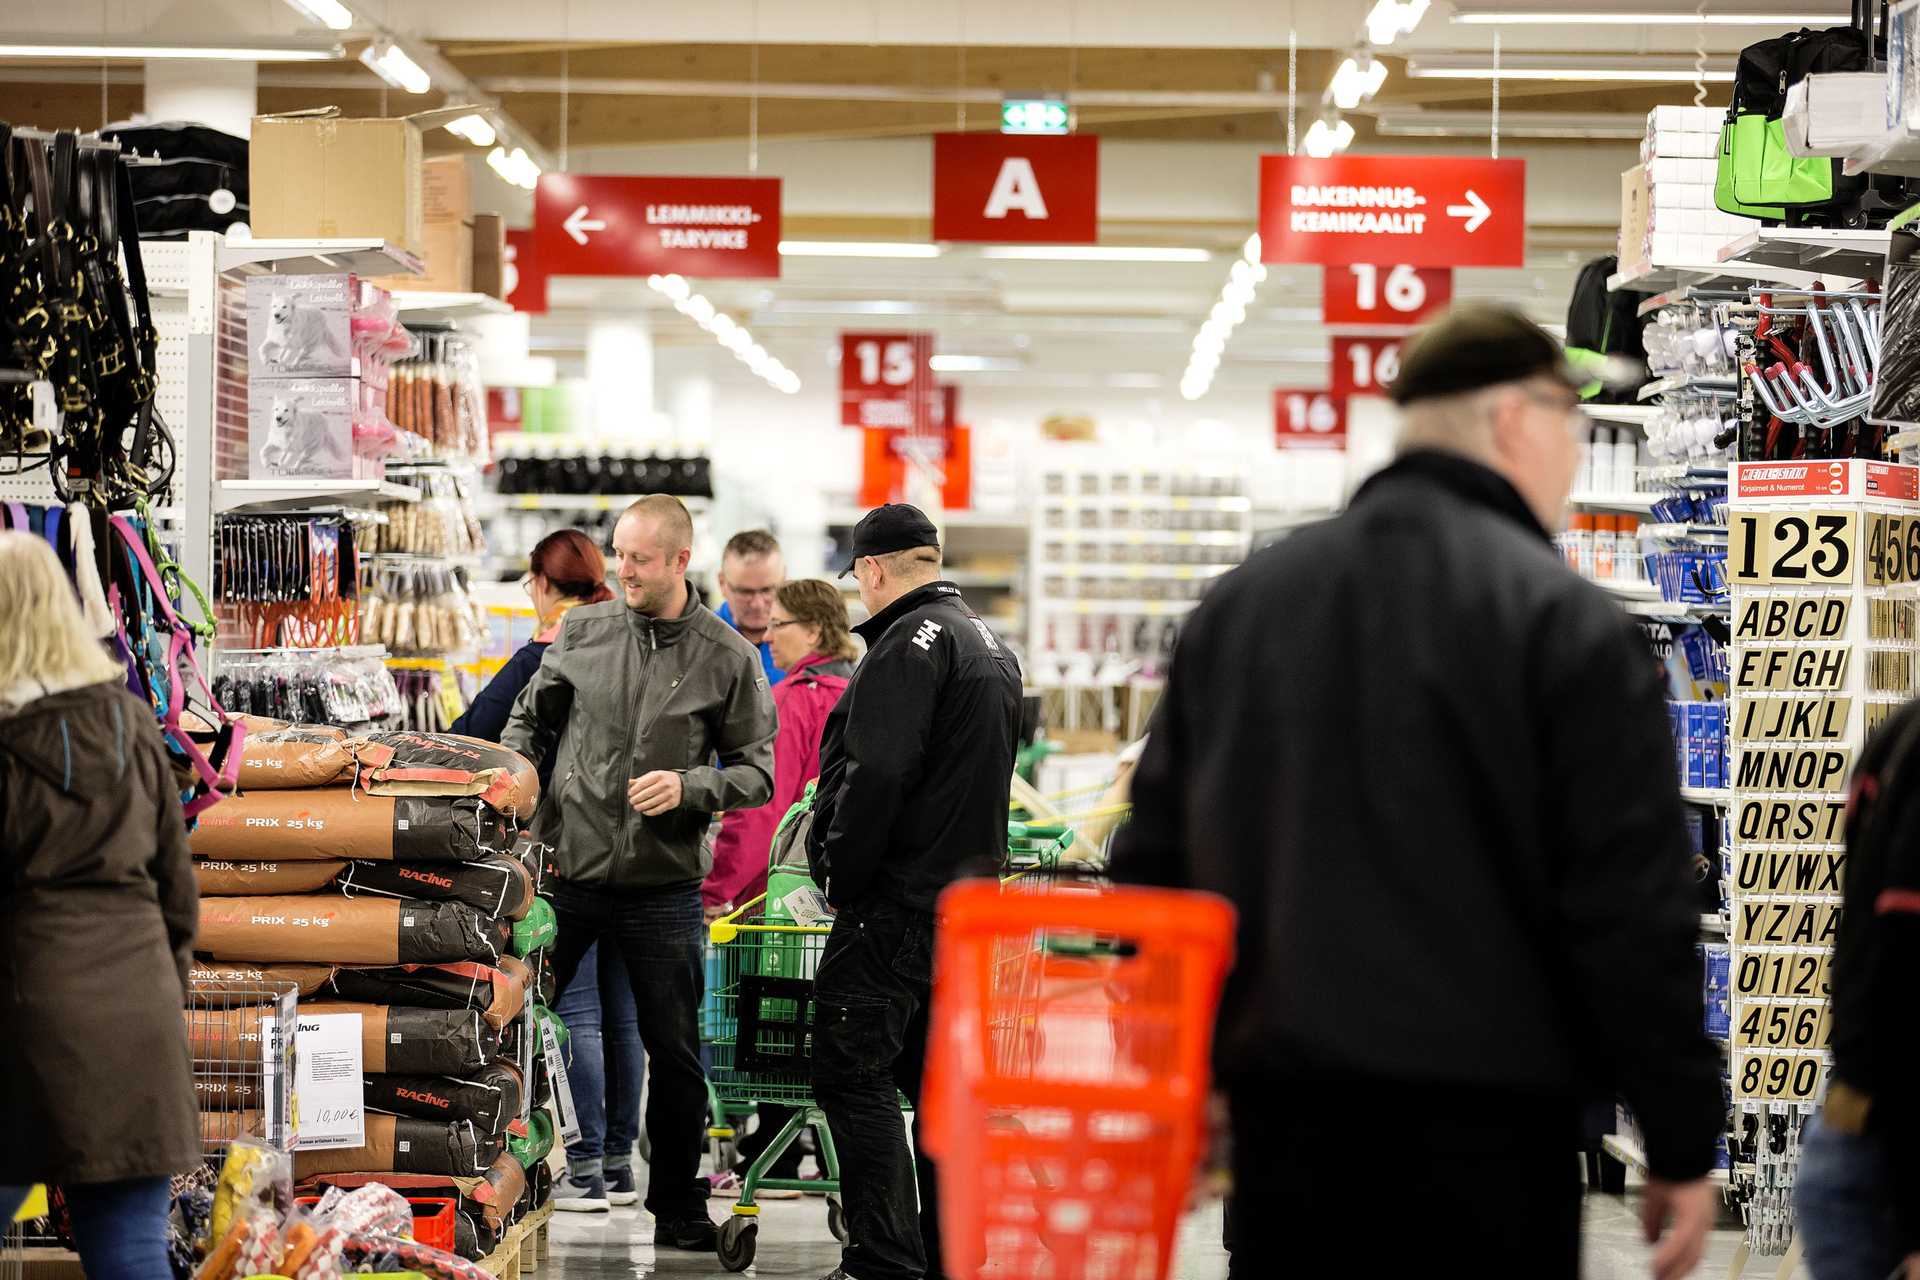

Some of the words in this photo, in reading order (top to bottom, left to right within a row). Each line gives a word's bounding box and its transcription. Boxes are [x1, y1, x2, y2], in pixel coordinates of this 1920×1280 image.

[983, 157, 1049, 219] A
[1290, 186, 1426, 208] RAKENNUS-
[646, 204, 762, 225] LEMMIKKI-
[1290, 211, 1426, 233] KEMIKAALIT
[659, 229, 748, 249] TARVIKE
[1350, 264, 1427, 312] 16
[856, 341, 914, 385] 15
[1286, 394, 1337, 433] 16
[911, 619, 942, 651] HH
[246, 760, 262, 768] 25
[266, 758, 283, 768] kg
[246, 818, 280, 827] PRIX
[287, 819, 304, 829] 25
[307, 818, 324, 830] kg
[200, 862, 234, 871] PRIX
[240, 863, 257, 872] 25
[260, 861, 277, 872] kg
[400, 867, 453, 888] RACING
[251, 916, 285, 925] PRIX
[292, 918, 309, 927] 25
[312, 916, 329, 927] kg
[188, 969, 220, 979] PRIX
[226, 971, 243, 980] 25
[247, 970, 263, 980] kg
[396, 1087, 449, 1109] RACING
